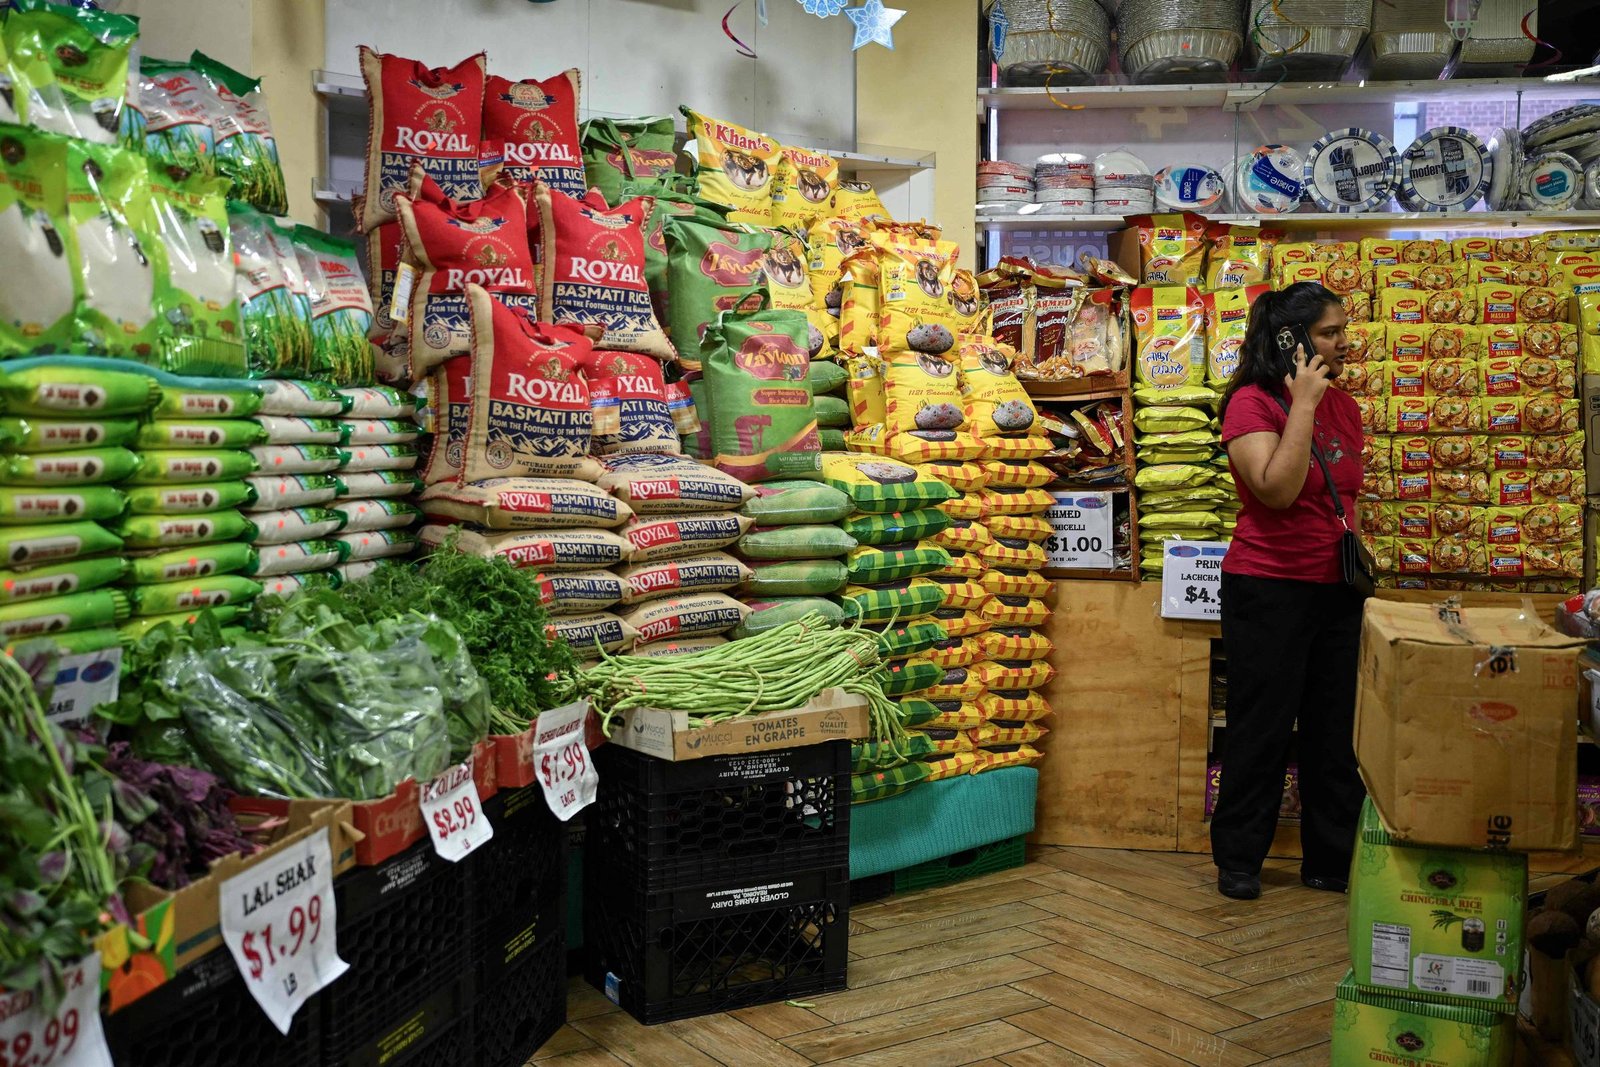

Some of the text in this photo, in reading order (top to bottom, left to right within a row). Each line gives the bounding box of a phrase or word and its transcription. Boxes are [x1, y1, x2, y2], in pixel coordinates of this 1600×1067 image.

[395, 126, 471, 154] ROYAL
[716, 124, 771, 152] Khan's
[504, 142, 573, 165] ROYAL
[791, 150, 830, 168] Khan's
[457, 160, 478, 171] RICE
[1352, 161, 1390, 178] modern
[1409, 163, 1446, 179] modern
[1270, 176, 1296, 193] Dixie
[446, 267, 527, 290] ROYAL
[569, 257, 640, 283] ROYAL
[506, 295, 536, 307] RICE
[555, 297, 572, 306] FROM
[573, 300, 584, 308] THE
[585, 300, 615, 311] FOOTHILLS
[556, 285, 650, 305] BASMATI RICE
[428, 304, 446, 312] FROM
[904, 306, 918, 314] 1121
[506, 373, 584, 404] ROYAL
[492, 403, 593, 425] BASMATI RICE
[647, 401, 669, 415] RICE
[488, 416, 507, 428] FROM
[510, 421, 521, 430] THE
[523, 422, 554, 435] FOOTHILLS
[631, 481, 741, 499] ROYAL BASMATI RICE
[500, 492, 615, 511] ROYAL BASMATI RICE
[631, 518, 737, 547] ROYAL BASMATI RICE
[555, 543, 594, 555] BASMATI
[597, 545, 619, 556] RICE
[1047, 535, 1102, 553] $1.00
[553, 579, 619, 591] BASMATI RICE
[629, 566, 738, 593] ROYAL BASMATI RICE
[1181, 573, 1220, 582] LACHCHA
[679, 609, 739, 624] BASMATI RICE
[596, 621, 619, 634] RICE
[644, 722, 666, 735] Mucci
[752, 717, 798, 733] TOMATES
[702, 731, 733, 744] Mucci
[745, 727, 805, 746] EN GRAPPE
[541, 742, 586, 789] $1.99
[765, 766, 790, 774] CLOVER
[560, 789, 576, 807] EACH
[433, 796, 475, 840] $2.99
[243, 854, 317, 916] LAL SHAK
[711, 892, 789, 909] CLOVER FARMS DAIRY
[1458, 899, 1482, 910] RICE
[242, 895, 321, 982] $1.99
[283, 972, 298, 997] LB
